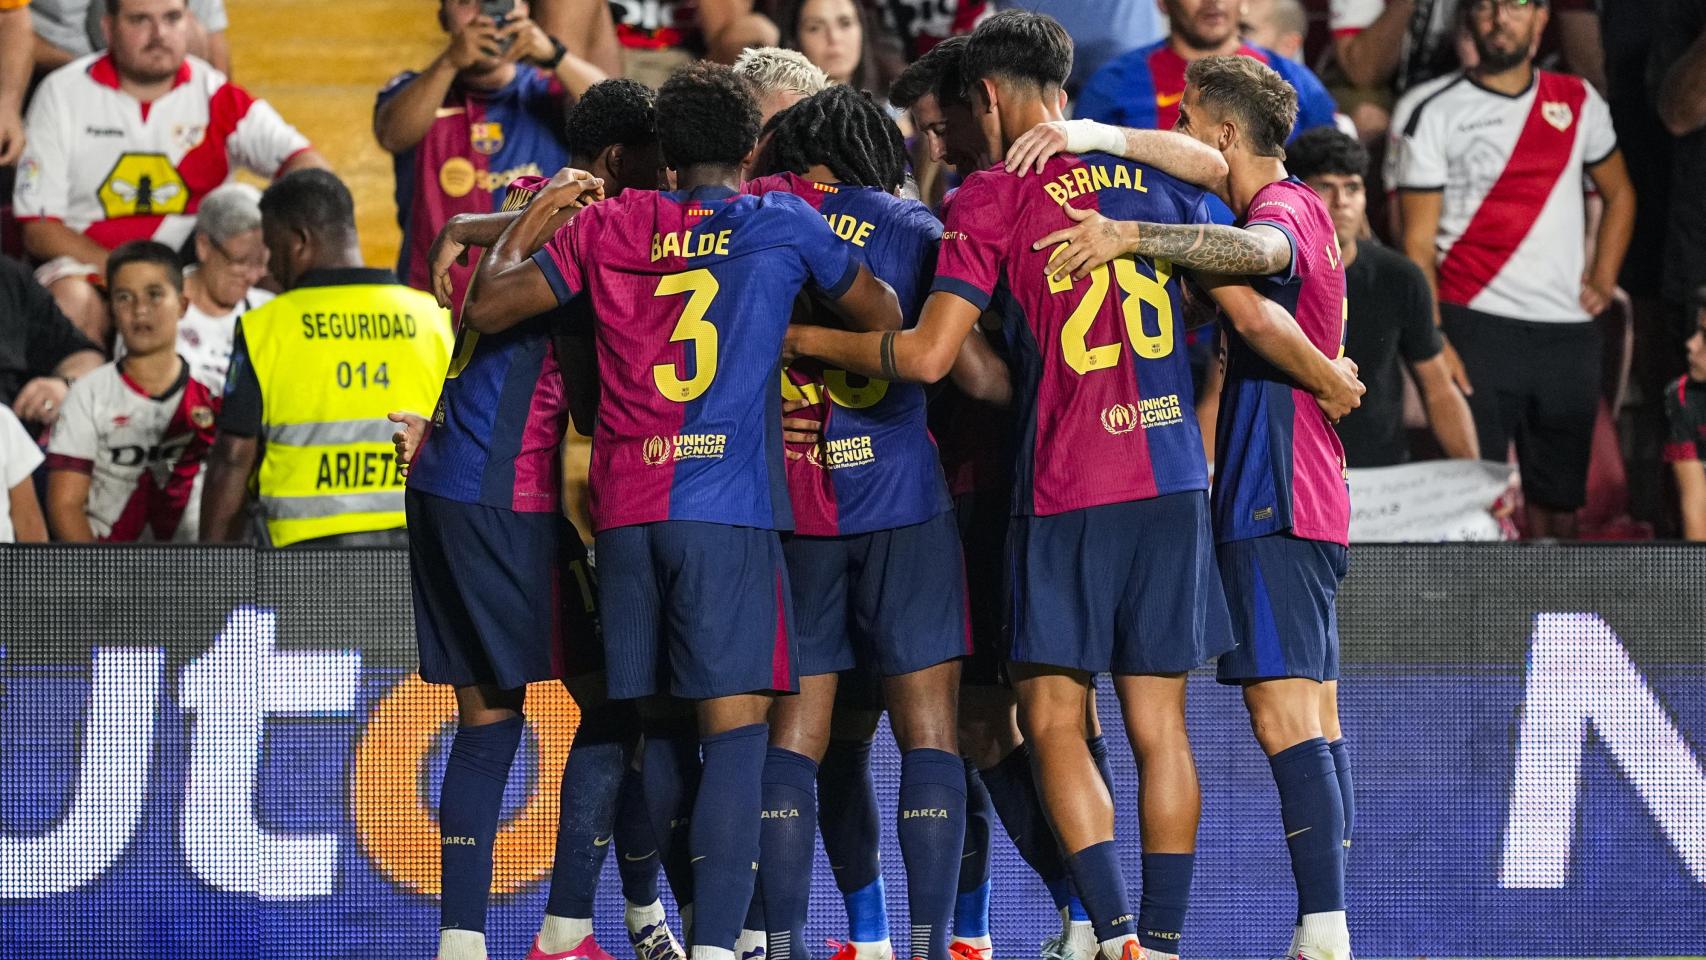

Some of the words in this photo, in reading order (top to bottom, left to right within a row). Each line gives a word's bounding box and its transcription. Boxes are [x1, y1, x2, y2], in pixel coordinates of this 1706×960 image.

[1044, 164, 1148, 207] BERNAL
[650, 229, 732, 262] BALDE
[1046, 240, 1174, 376] 28
[302, 313, 417, 340] SEGURIDAD
[653, 268, 720, 402] 3
[337, 360, 391, 389] 014
[1138, 394, 1179, 412] UNHCR
[1140, 406, 1182, 425] ACNUR
[672, 434, 727, 446] UNHCR
[673, 445, 724, 458] ACNUR
[826, 448, 874, 465] ACNUR
